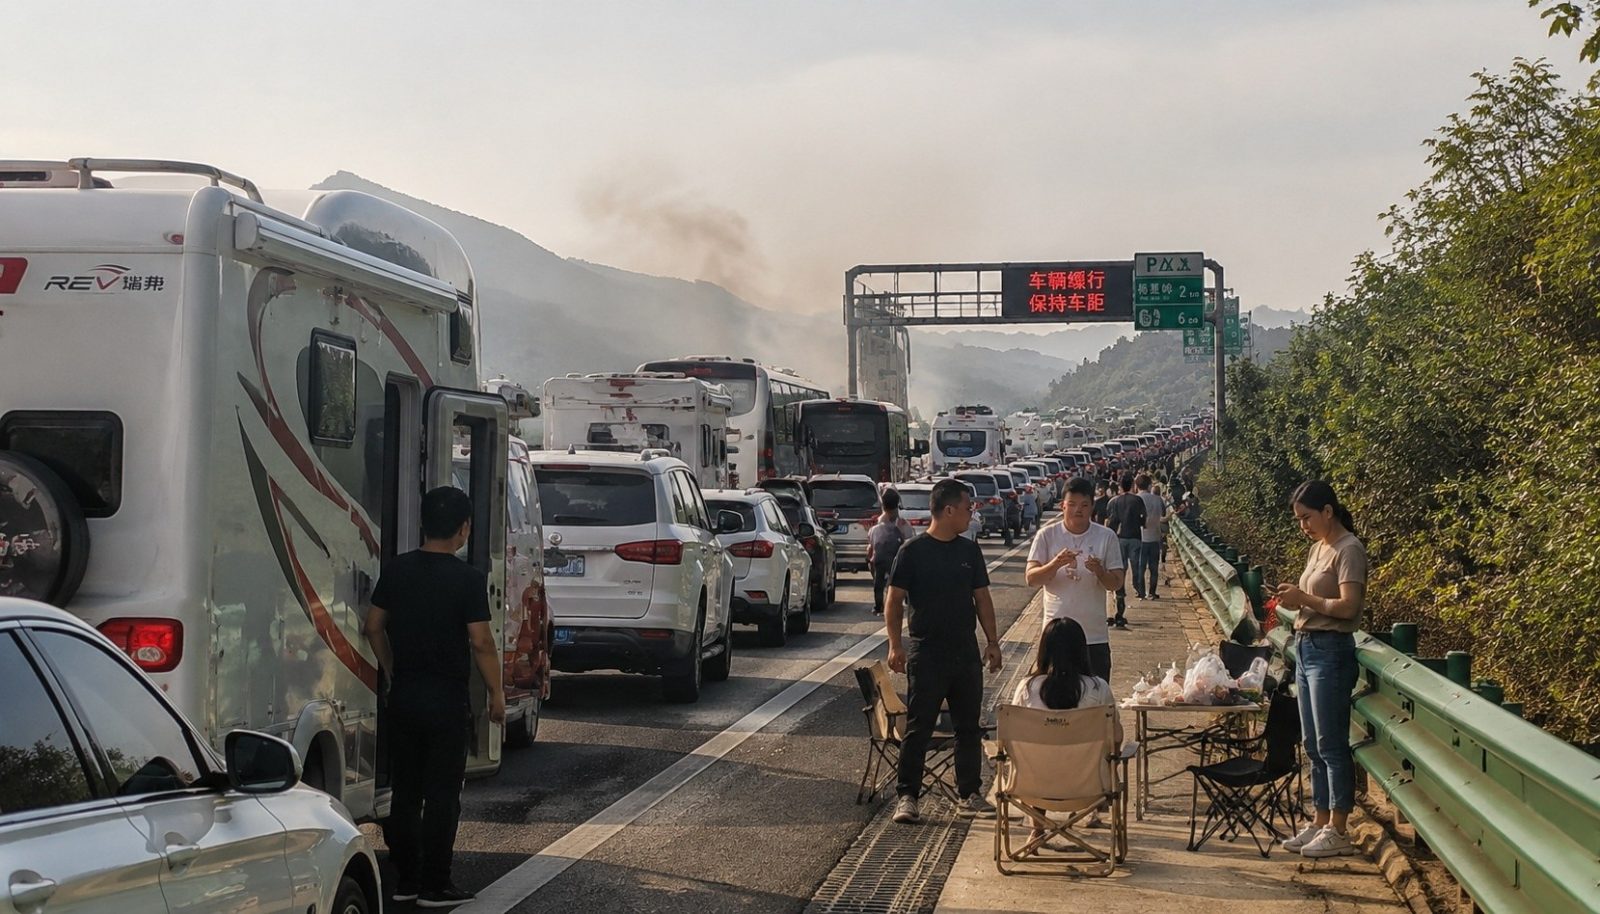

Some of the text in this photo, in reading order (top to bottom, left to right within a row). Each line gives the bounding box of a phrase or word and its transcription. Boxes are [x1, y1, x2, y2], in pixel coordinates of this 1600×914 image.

[44, 275, 165, 291] REV 瑞弗
[1029, 293, 1105, 313] 保持车距
